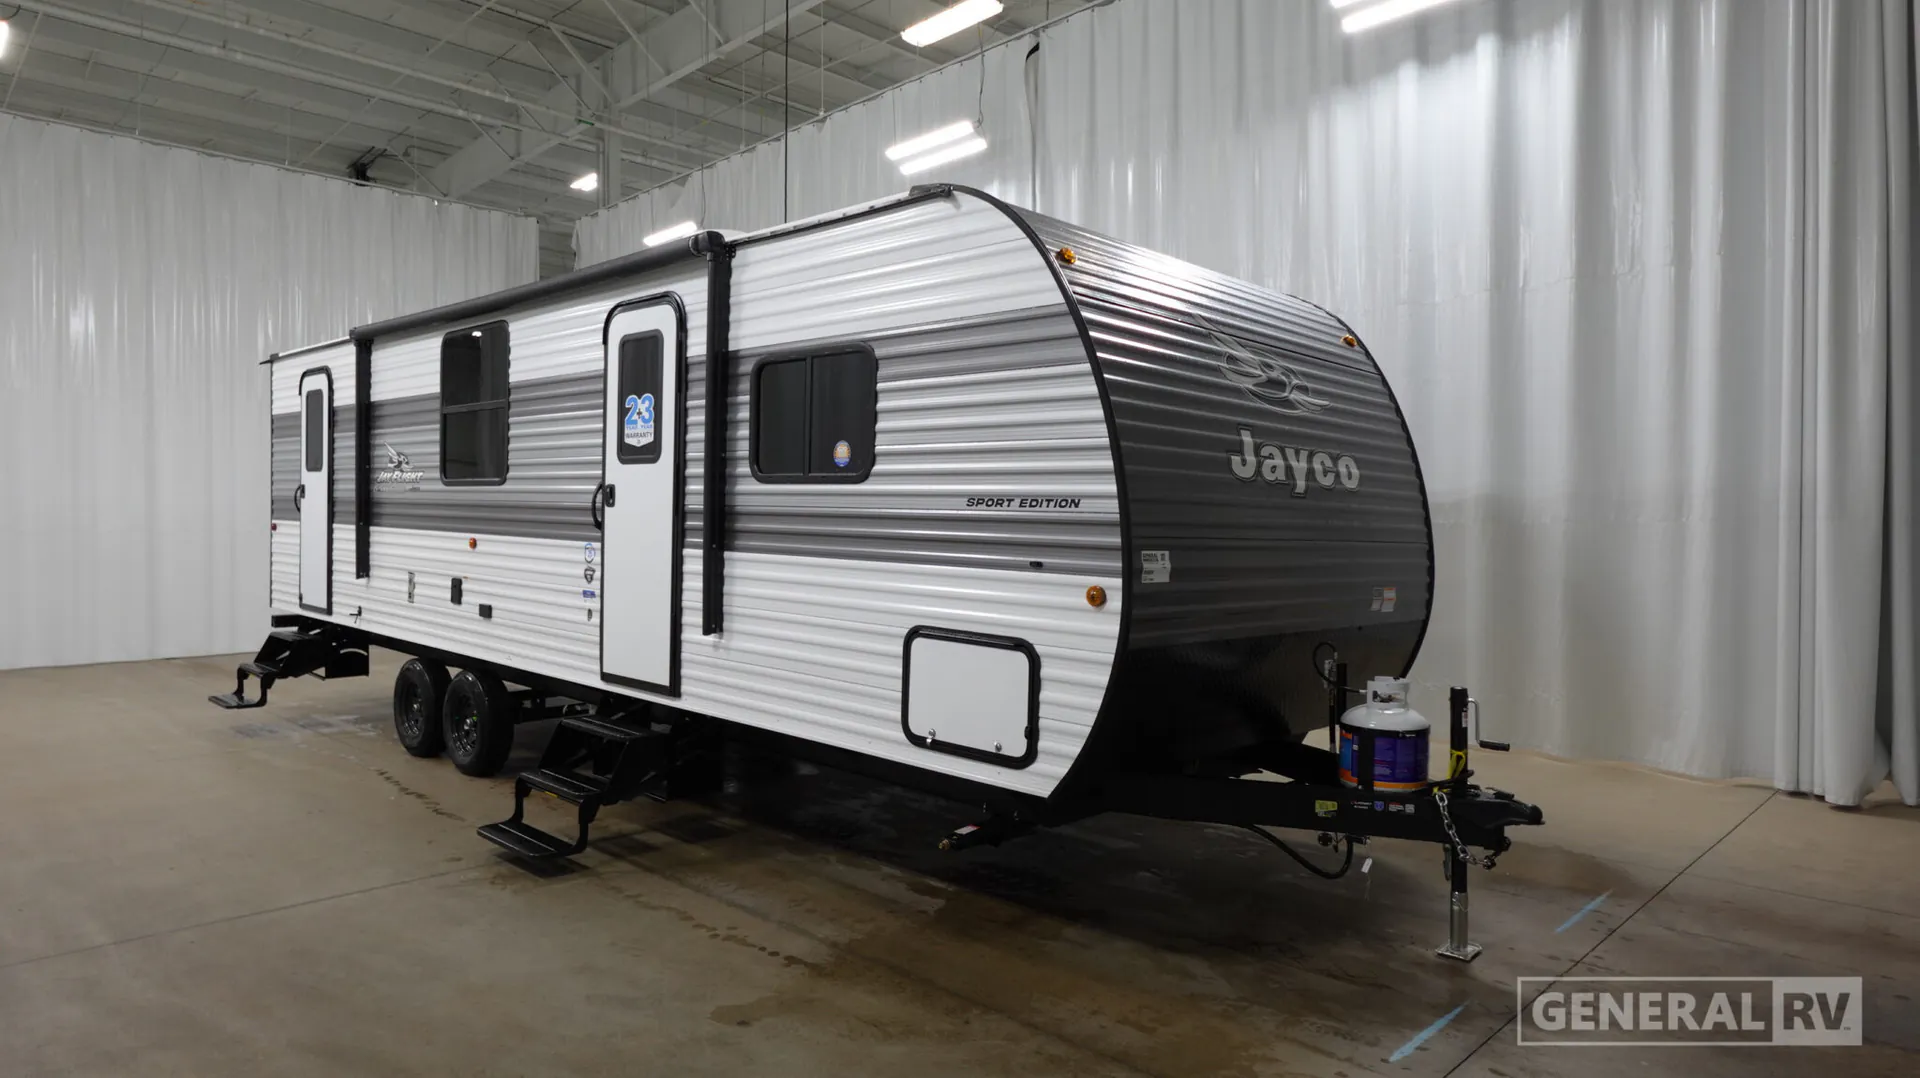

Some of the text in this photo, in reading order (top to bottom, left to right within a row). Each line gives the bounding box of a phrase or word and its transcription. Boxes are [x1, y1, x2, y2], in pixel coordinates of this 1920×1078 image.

[1229, 426, 1361, 497] Jayco
[966, 497, 1081, 509] SPORT EDITION
